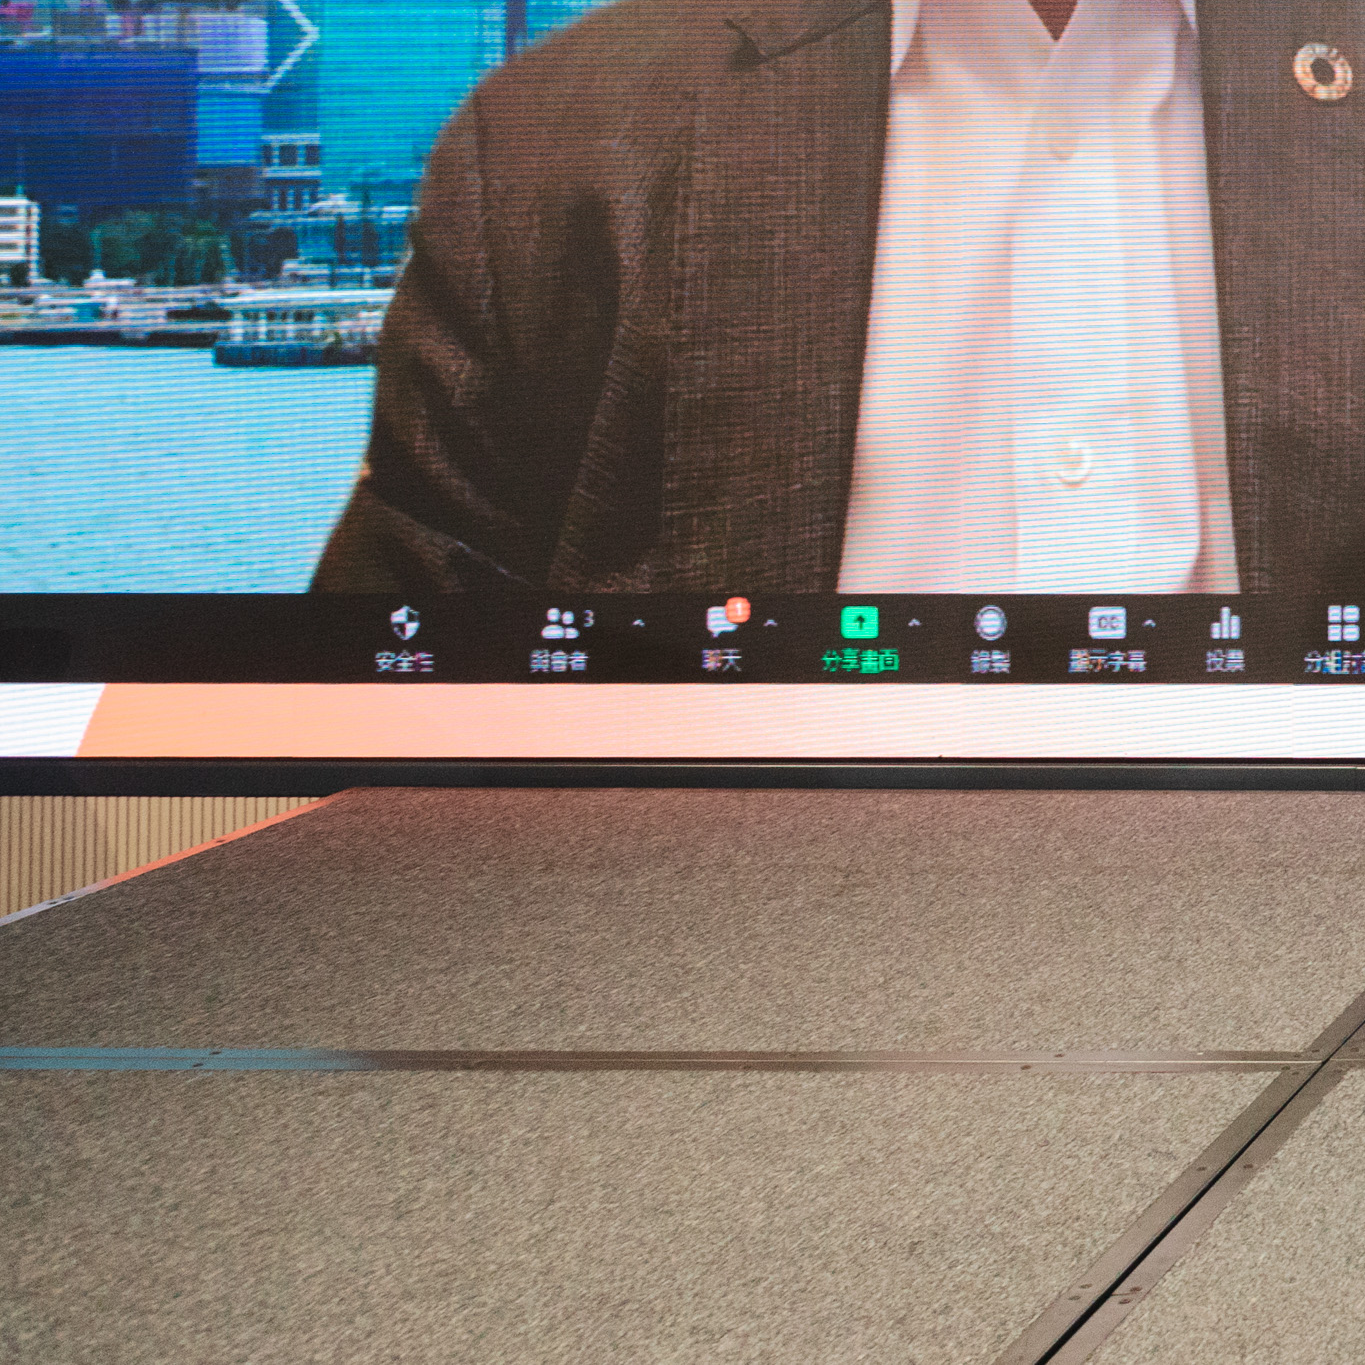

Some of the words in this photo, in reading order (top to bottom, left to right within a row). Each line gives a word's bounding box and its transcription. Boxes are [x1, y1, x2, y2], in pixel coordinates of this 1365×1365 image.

[583, 609, 595, 628] 3
[822, 648, 900, 674] 分享畫面
